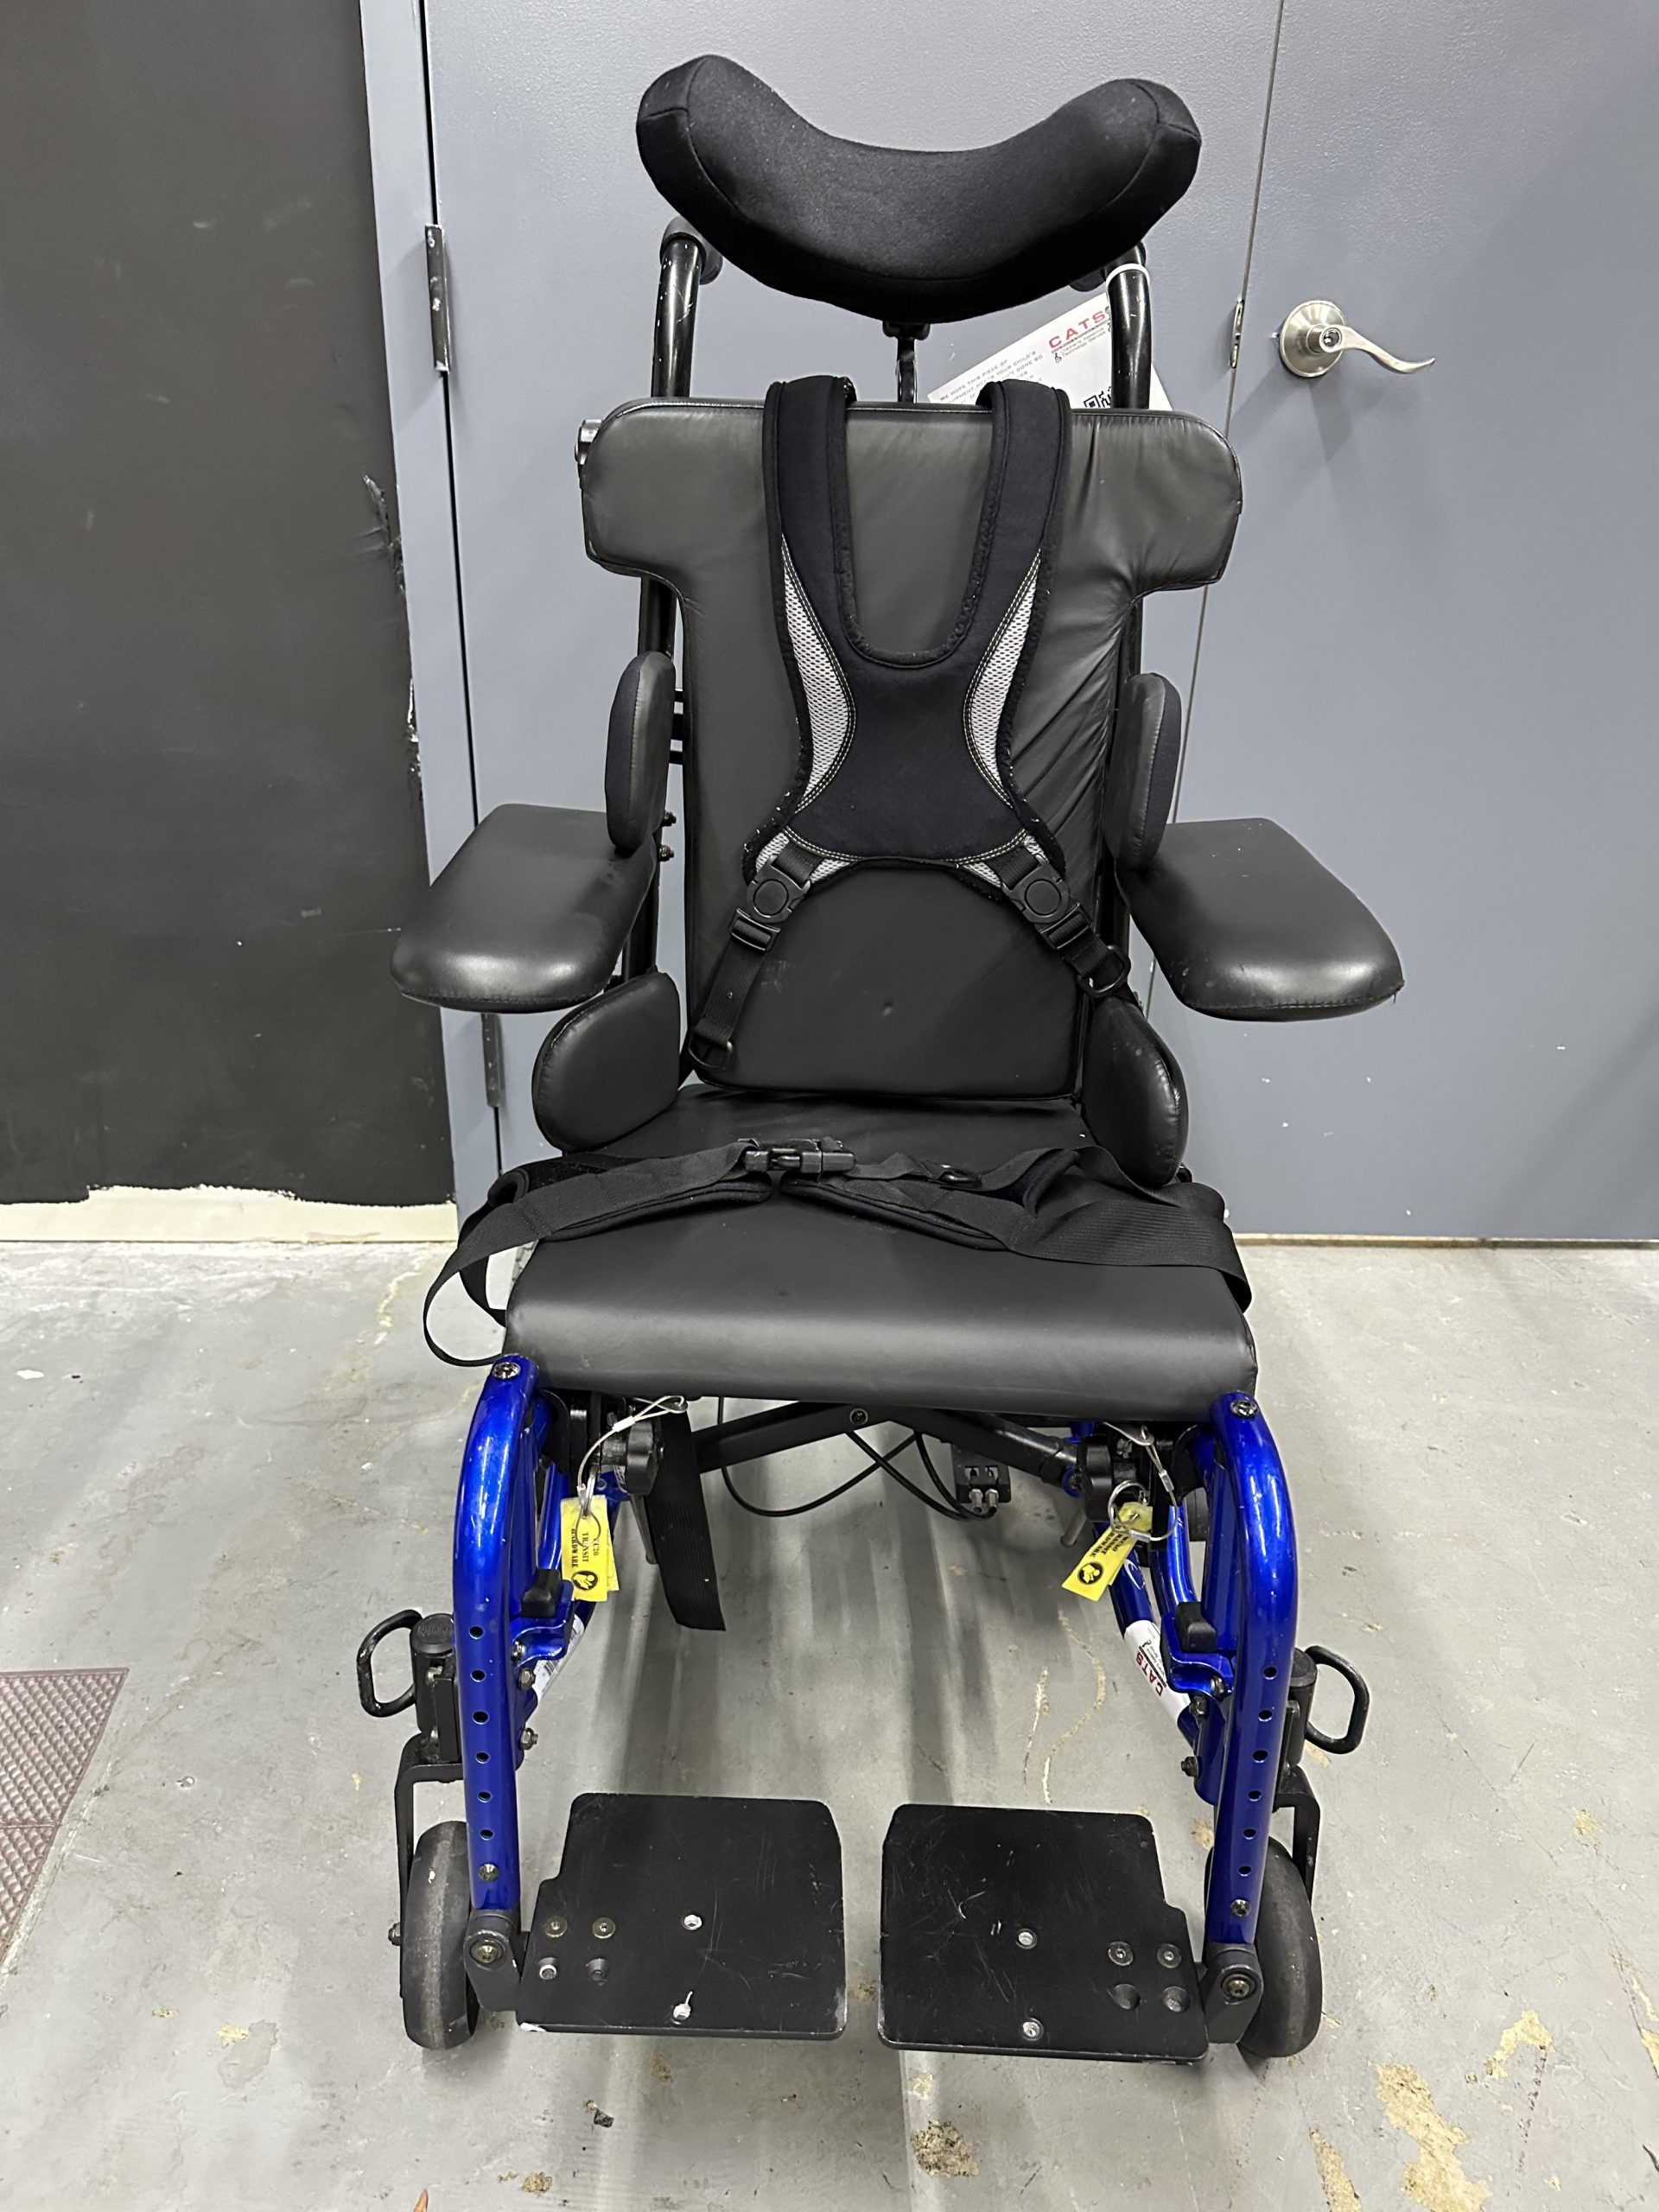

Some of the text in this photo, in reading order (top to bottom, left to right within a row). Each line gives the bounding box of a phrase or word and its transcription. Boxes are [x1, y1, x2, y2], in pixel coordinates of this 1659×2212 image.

[1048, 310, 1106, 348] CATS
[996, 365, 1012, 376] YOUR
[950, 385, 966, 396] HOPE
[1101, 1534, 1122, 1555] RANSIT
[1135, 1651, 1164, 1697] CATS
